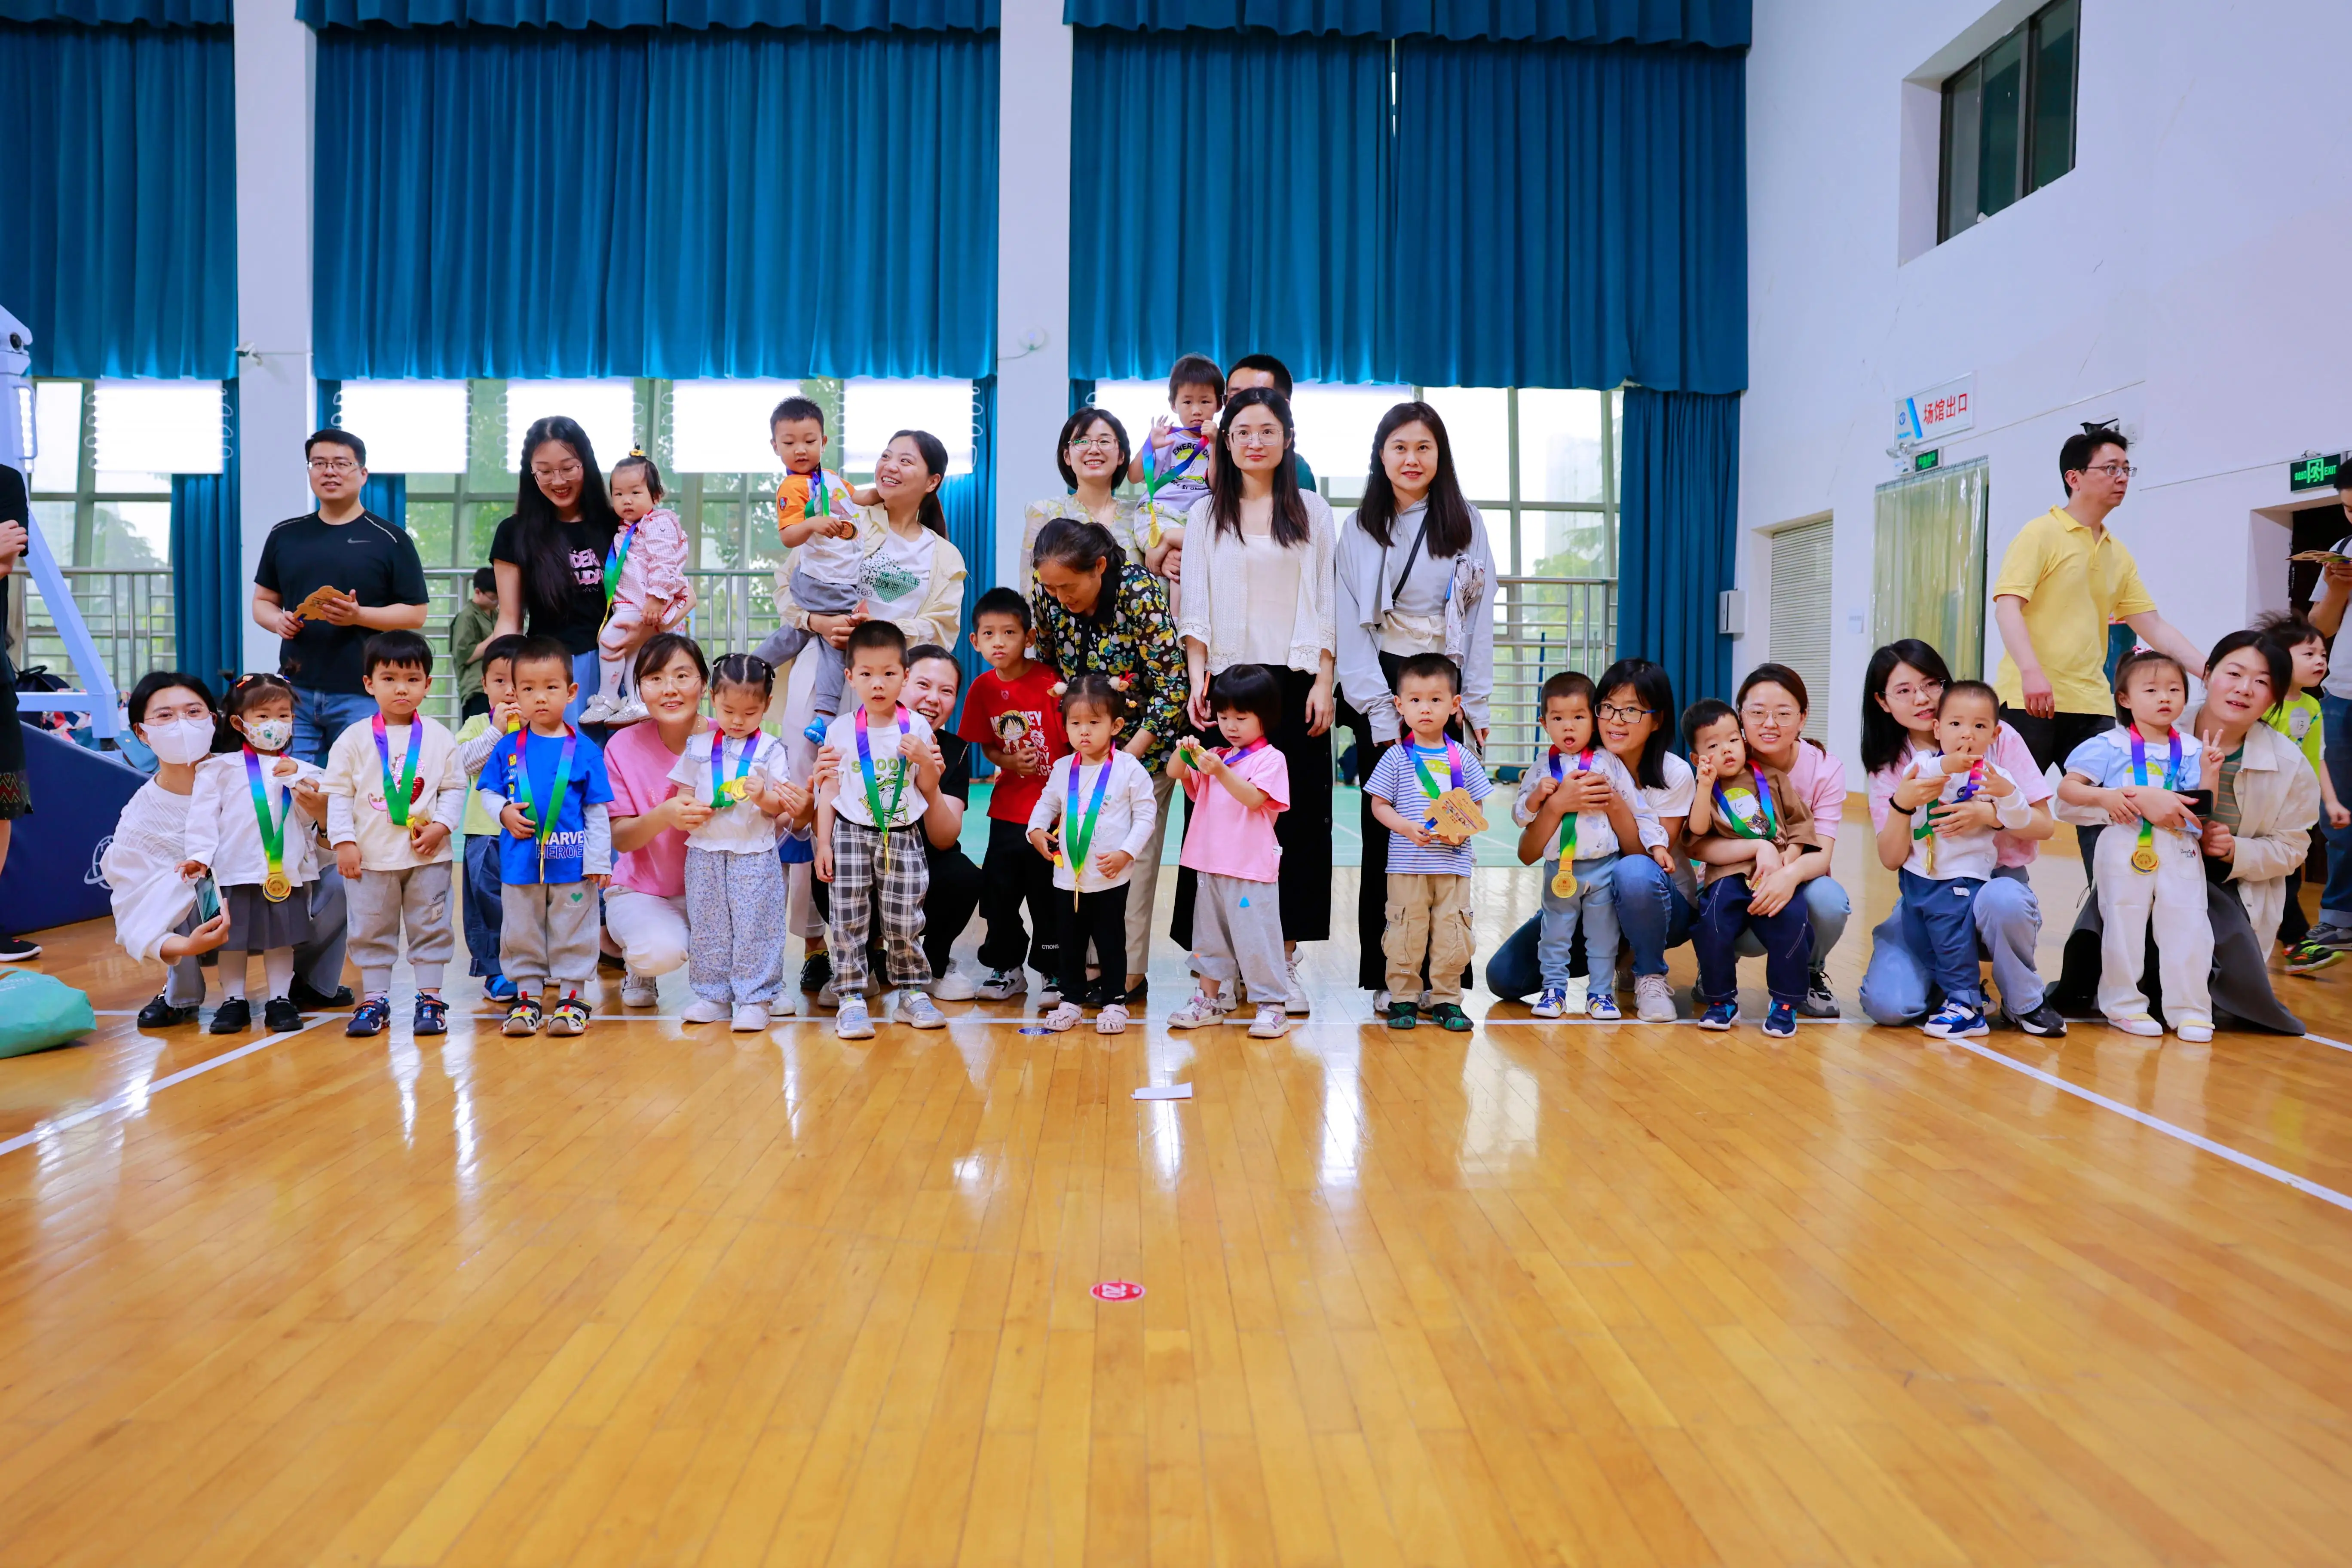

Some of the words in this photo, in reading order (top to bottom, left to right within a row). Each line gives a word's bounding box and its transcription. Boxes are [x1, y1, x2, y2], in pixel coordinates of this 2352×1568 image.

[1923, 393, 1967, 425] 场馆出口
[1172, 443, 1197, 456] ENERG
[1190, 461, 1196, 473] 6
[2324, 465, 2337, 475] EXIT
[990, 710, 1042, 732] MKEY
[2297, 720, 2304, 731] 13
[851, 758, 913, 773] SOOY
